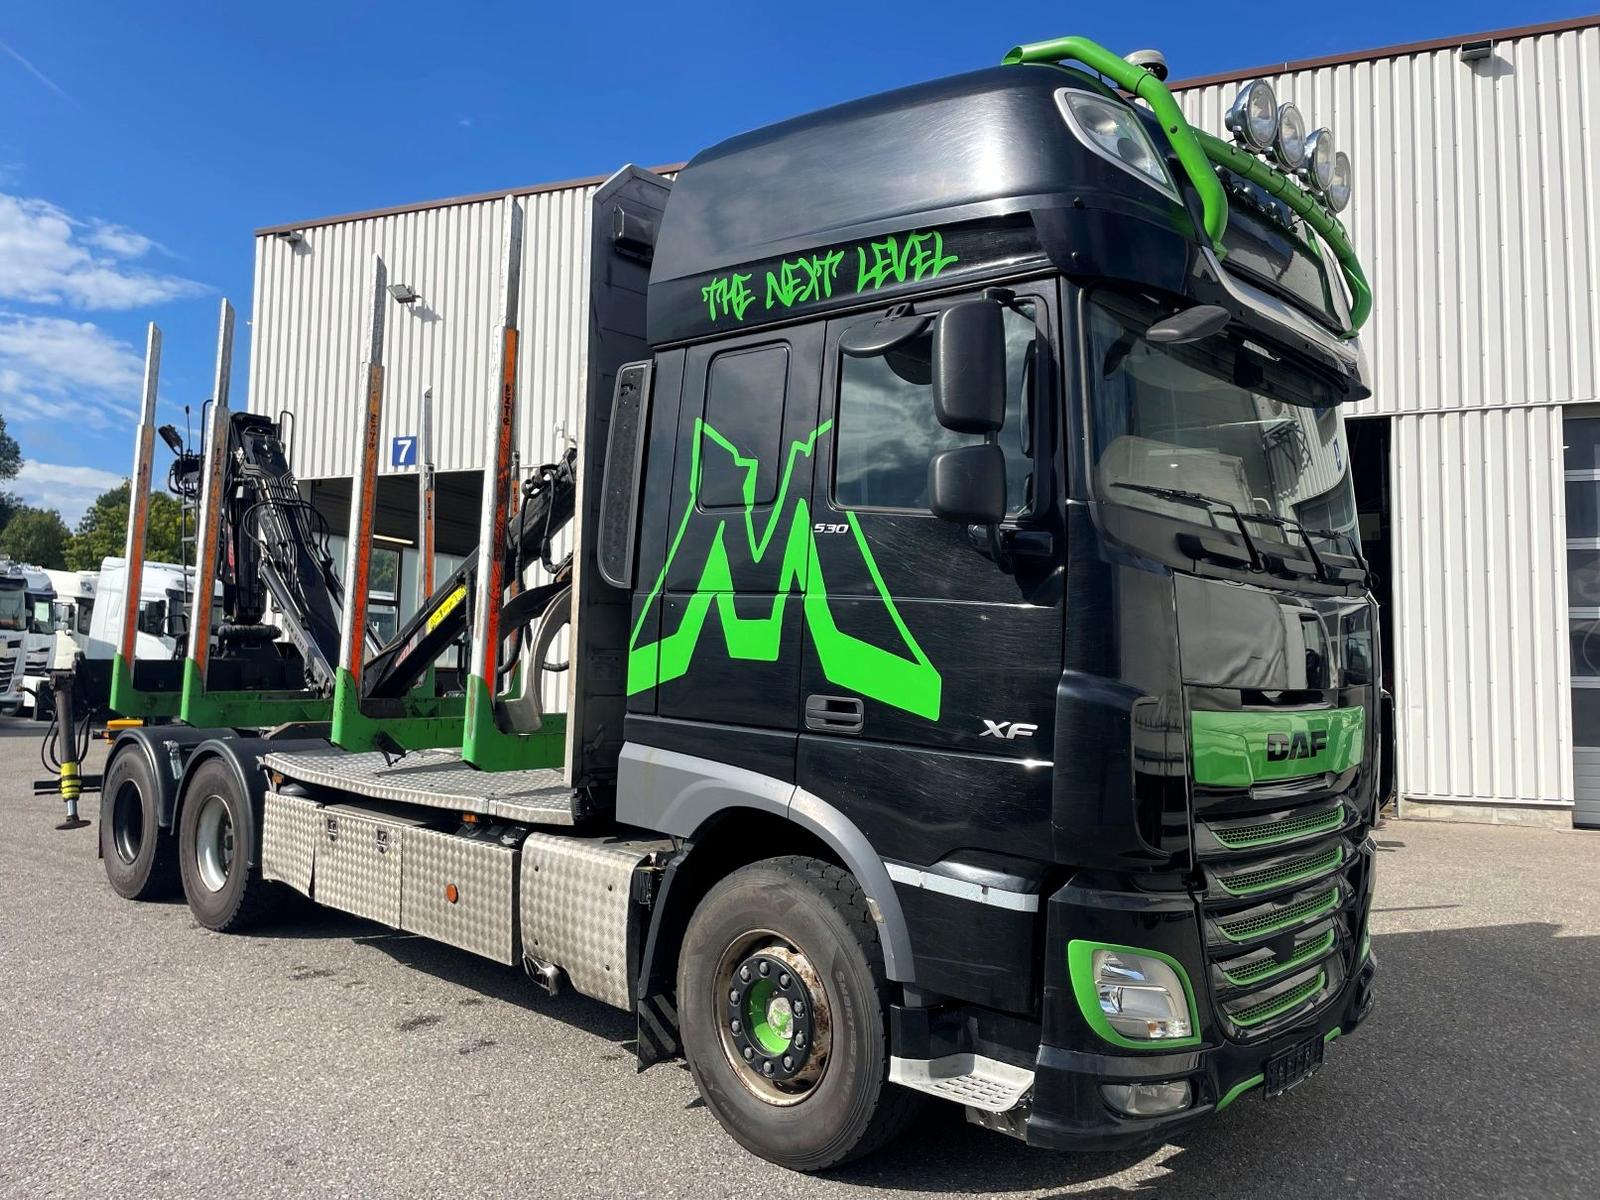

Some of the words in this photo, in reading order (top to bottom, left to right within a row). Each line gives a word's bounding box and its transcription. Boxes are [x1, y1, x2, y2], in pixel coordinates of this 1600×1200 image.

[702, 273, 756, 321] THE
[766, 249, 844, 310] NEXT
[857, 230, 959, 294] LEVEL
[397, 439, 412, 463] 7
[814, 523, 849, 534] 530
[979, 719, 1039, 740] XF
[1267, 729, 1327, 762] DAF
